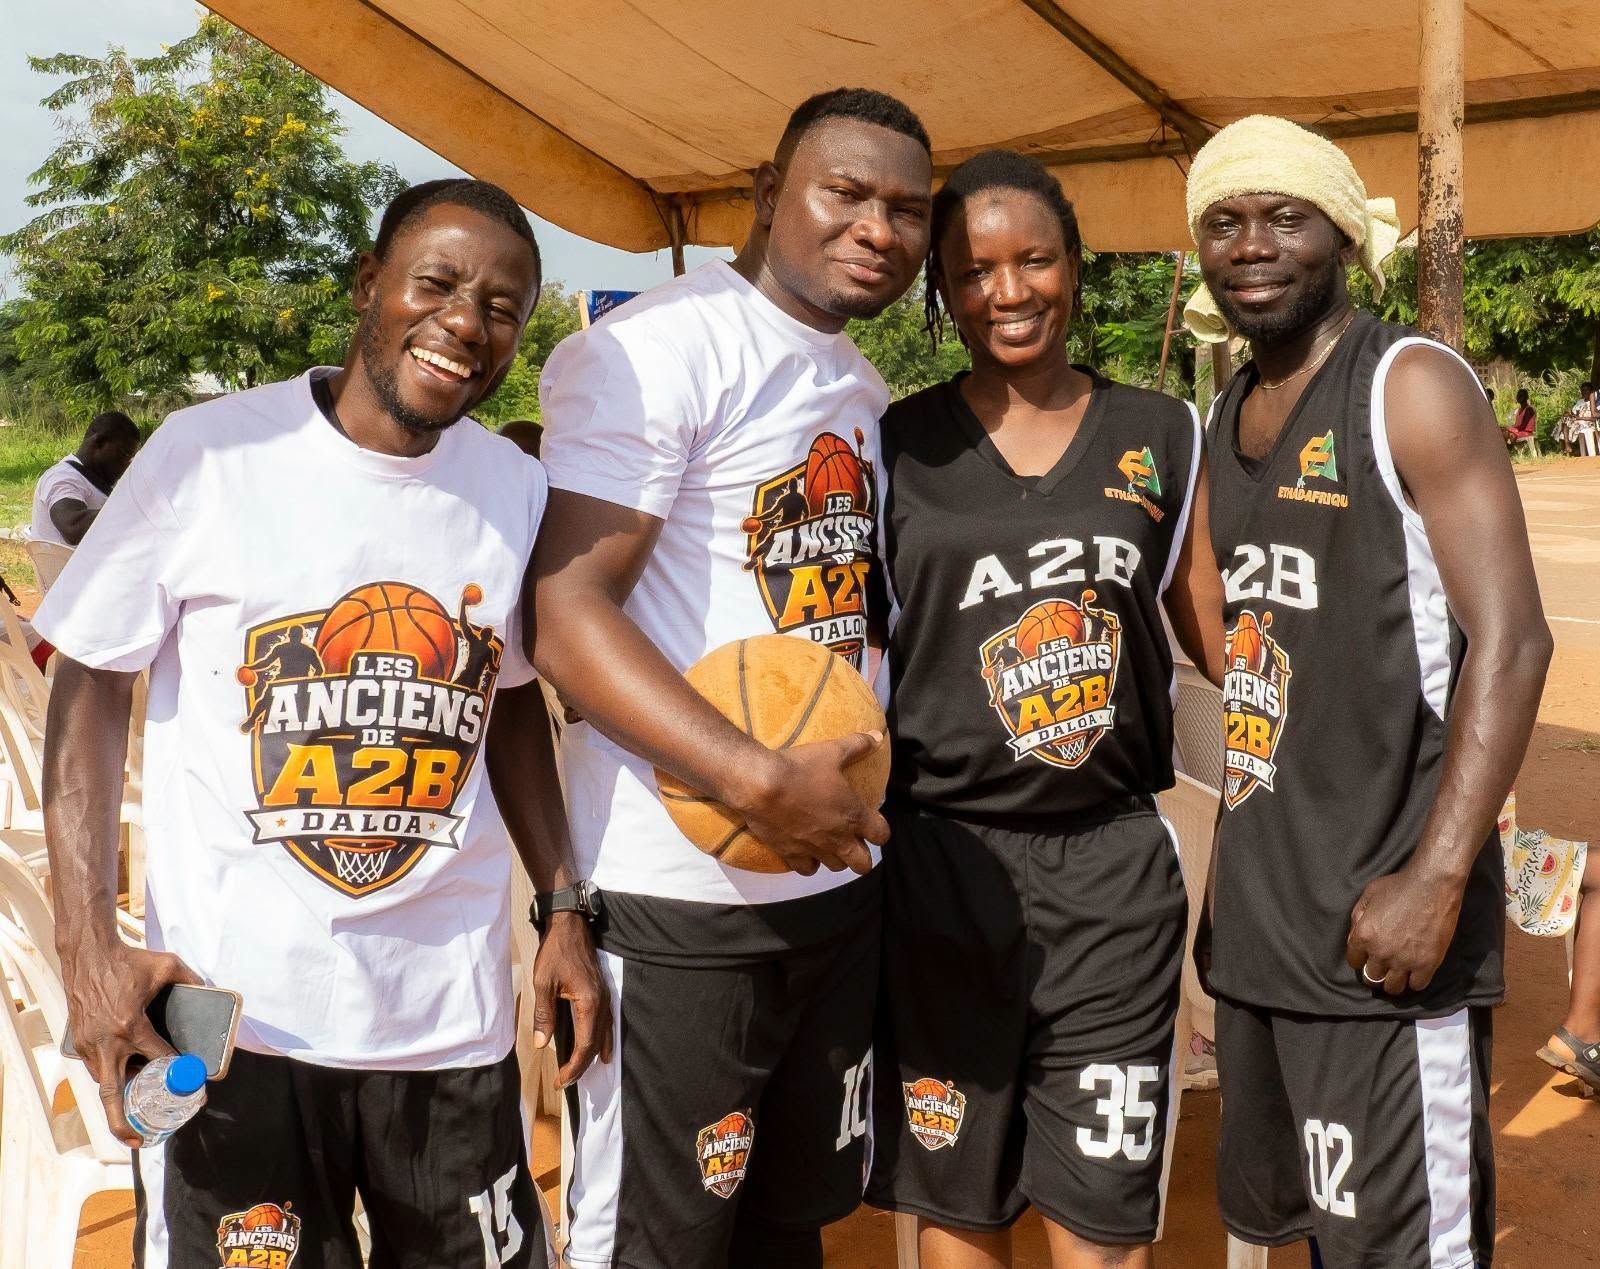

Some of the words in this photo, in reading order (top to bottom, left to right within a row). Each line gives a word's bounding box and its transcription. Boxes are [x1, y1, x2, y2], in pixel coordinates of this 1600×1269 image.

[826, 496, 852, 515] LES
[765, 515, 874, 567] ANCIEN
[959, 536, 1141, 610] A2B
[1221, 544, 1318, 609] 2B
[810, 616, 865, 642] DALO
[1040, 638, 1070, 655] LES
[356, 656, 413, 678] LES
[1003, 644, 1112, 701] ANCIENS
[1235, 657, 1246, 670] ES
[1052, 677, 1070, 690] DE
[1224, 671, 1280, 718] NCIENS
[263, 679, 484, 744] ANCIENS
[1017, 675, 1107, 736] A2B
[1230, 700, 1241, 712] DE
[361, 729, 395, 745] DE
[1038, 714, 1098, 741] DALOA
[1224, 712, 1270, 759] 2B
[263, 743, 462, 809] A2B
[301, 812, 421, 834] DALOA
[909, 1097, 960, 1120] ANCIENS
[1076, 1063, 1159, 1160] 35
[912, 1110, 955, 1135] A2B
[703, 1137, 751, 1159] ANCIENS
[706, 1151, 746, 1177] A2B
[1303, 1118, 1356, 1218] 02
[469, 1164, 524, 1269] 15
[224, 1232, 296, 1251] ANCIENS
[226, 1248, 288, 1269] A2B
